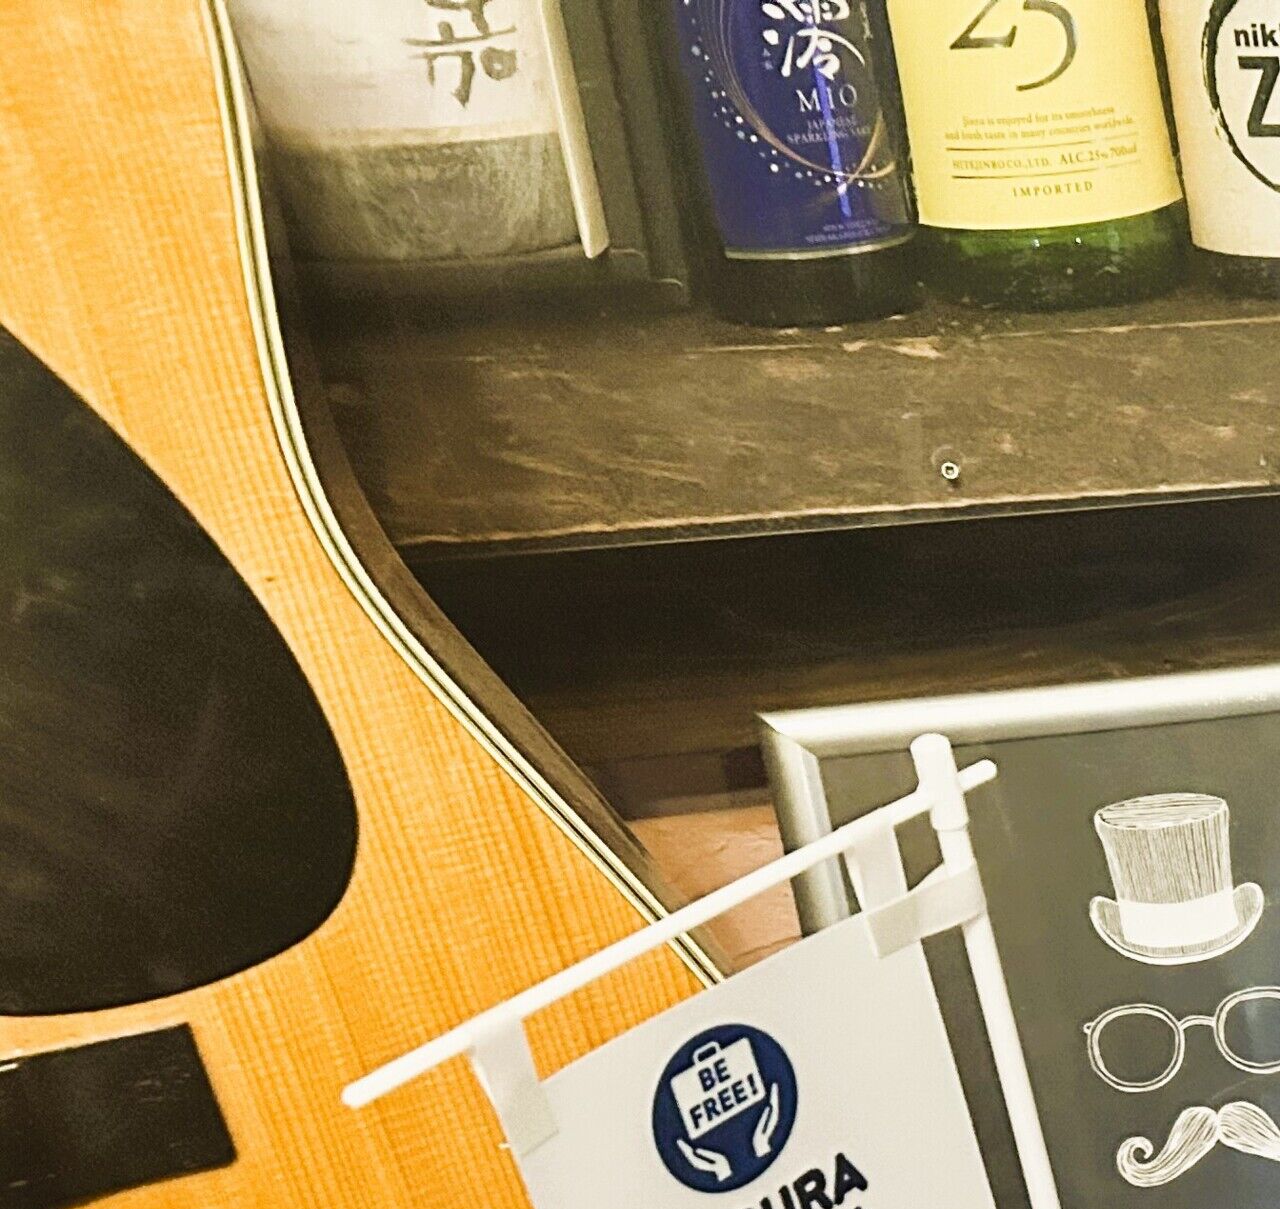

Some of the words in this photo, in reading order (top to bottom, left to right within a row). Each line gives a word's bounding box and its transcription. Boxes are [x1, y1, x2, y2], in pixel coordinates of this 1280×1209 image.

[796, 84, 858, 113] MIO
[1012, 180, 1093, 198] IMPORTED
[697, 1057, 731, 1093] BE
[689, 1072, 760, 1130] FREE!
